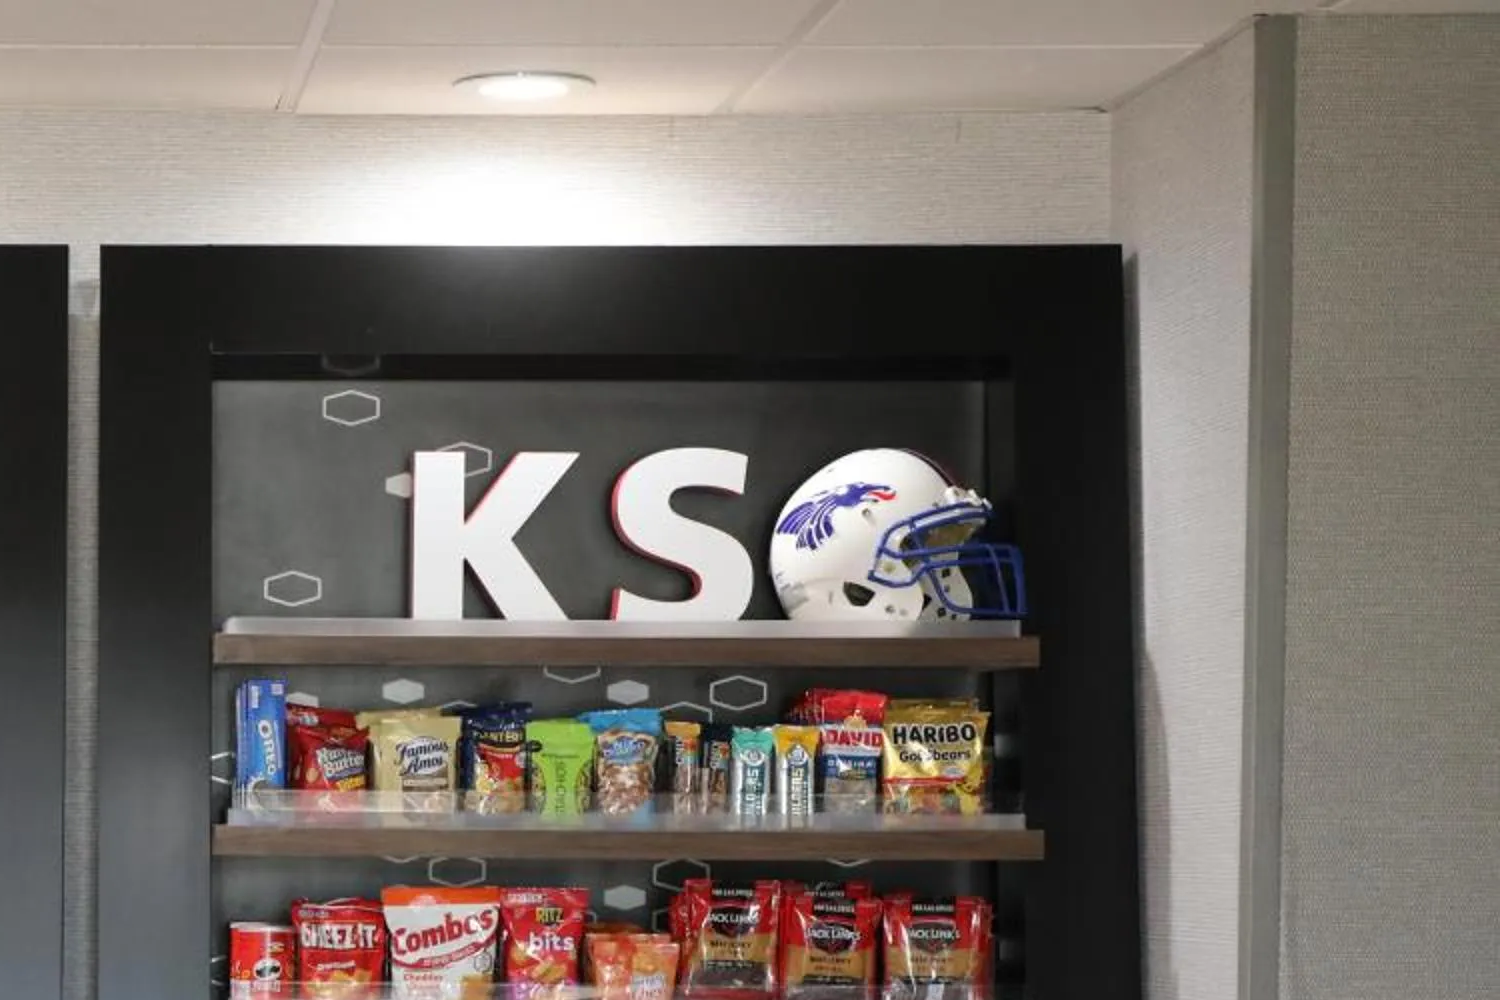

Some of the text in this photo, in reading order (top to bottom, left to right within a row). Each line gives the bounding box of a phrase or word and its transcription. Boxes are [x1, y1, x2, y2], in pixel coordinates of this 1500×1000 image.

[826, 729, 883, 748] DAVID
[892, 723, 977, 746] HARIBO
[257, 719, 276, 775] OREO
[900, 749, 971, 762] Gobears
[393, 908, 493, 956] Combos
[529, 931, 575, 951] bits
